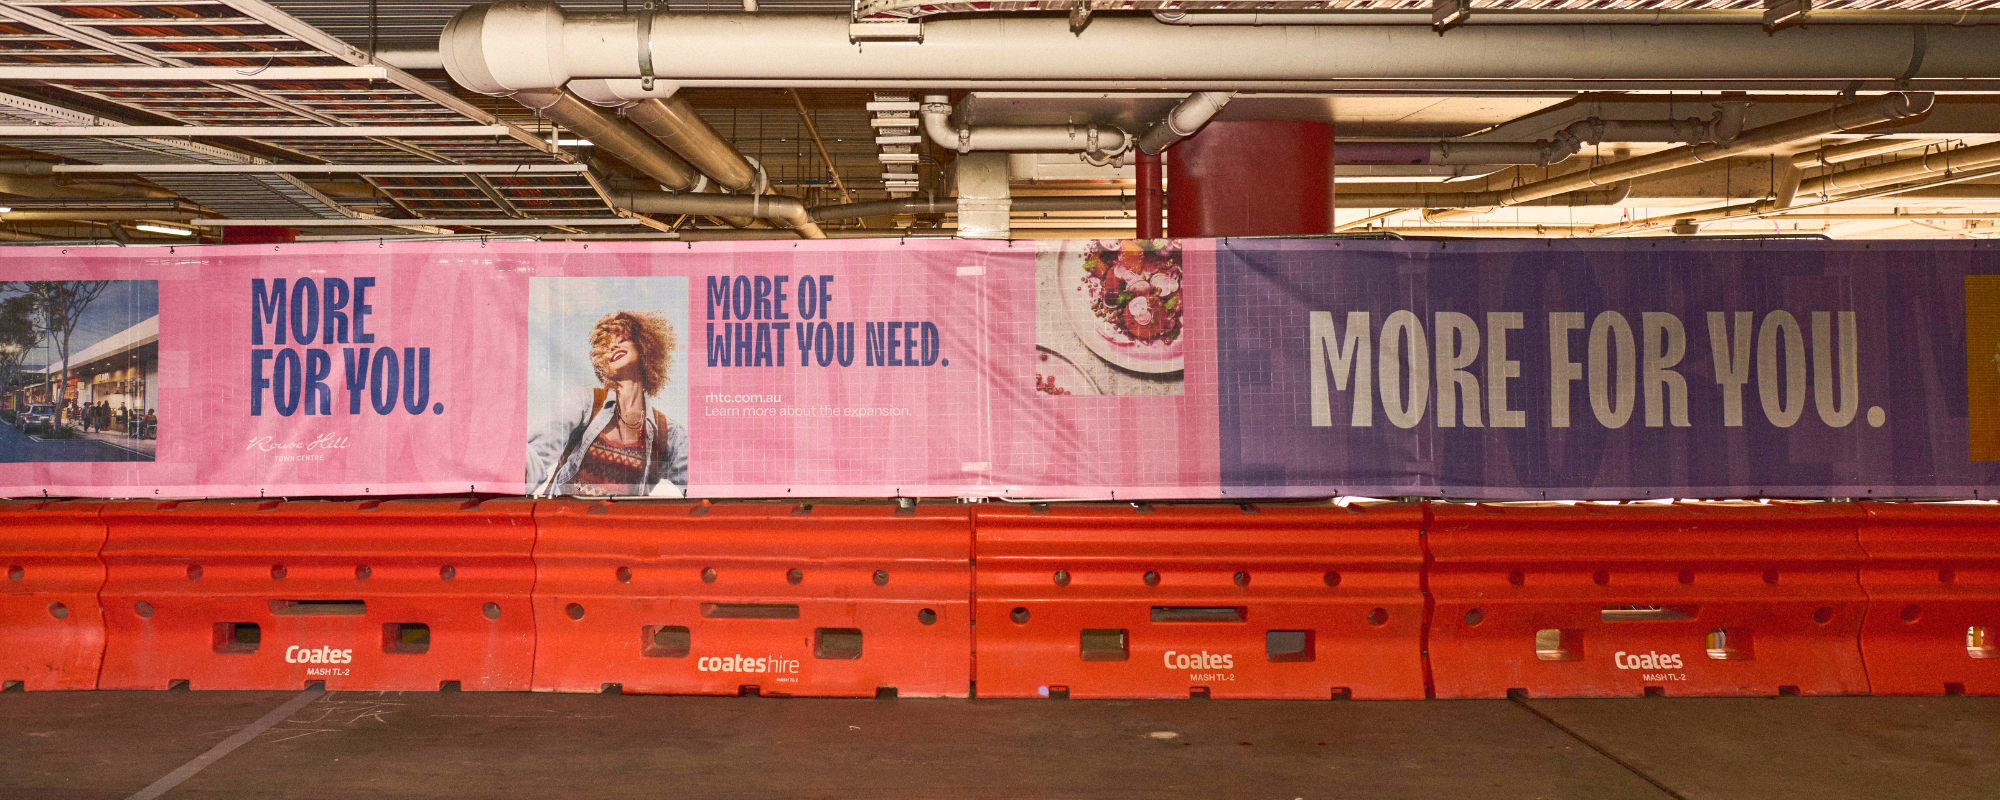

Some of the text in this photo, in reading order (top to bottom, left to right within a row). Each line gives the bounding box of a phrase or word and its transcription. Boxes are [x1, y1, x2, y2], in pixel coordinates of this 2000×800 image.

[706, 275, 834, 321] MORE OF
[251, 276, 376, 346] MORE
[706, 322, 949, 367] WHAT YOU NEED.
[1309, 309, 1886, 429] MORE FOR YOU.
[251, 347, 444, 416] FOR YOU.
[705, 391, 782, 403] rhtc.com.au
[705, 406, 912, 419] Learn more about the expansion.
[246, 431, 349, 452] Rouse Hill
[285, 645, 353, 664] Coates
[1163, 650, 1234, 669] Coates
[1614, 650, 1683, 670] Coates
[306, 668, 350, 676] MASH TL-2
[1216, 673, 1235, 681] TL-2
[1642, 673, 1687, 681] MASH TL-2
